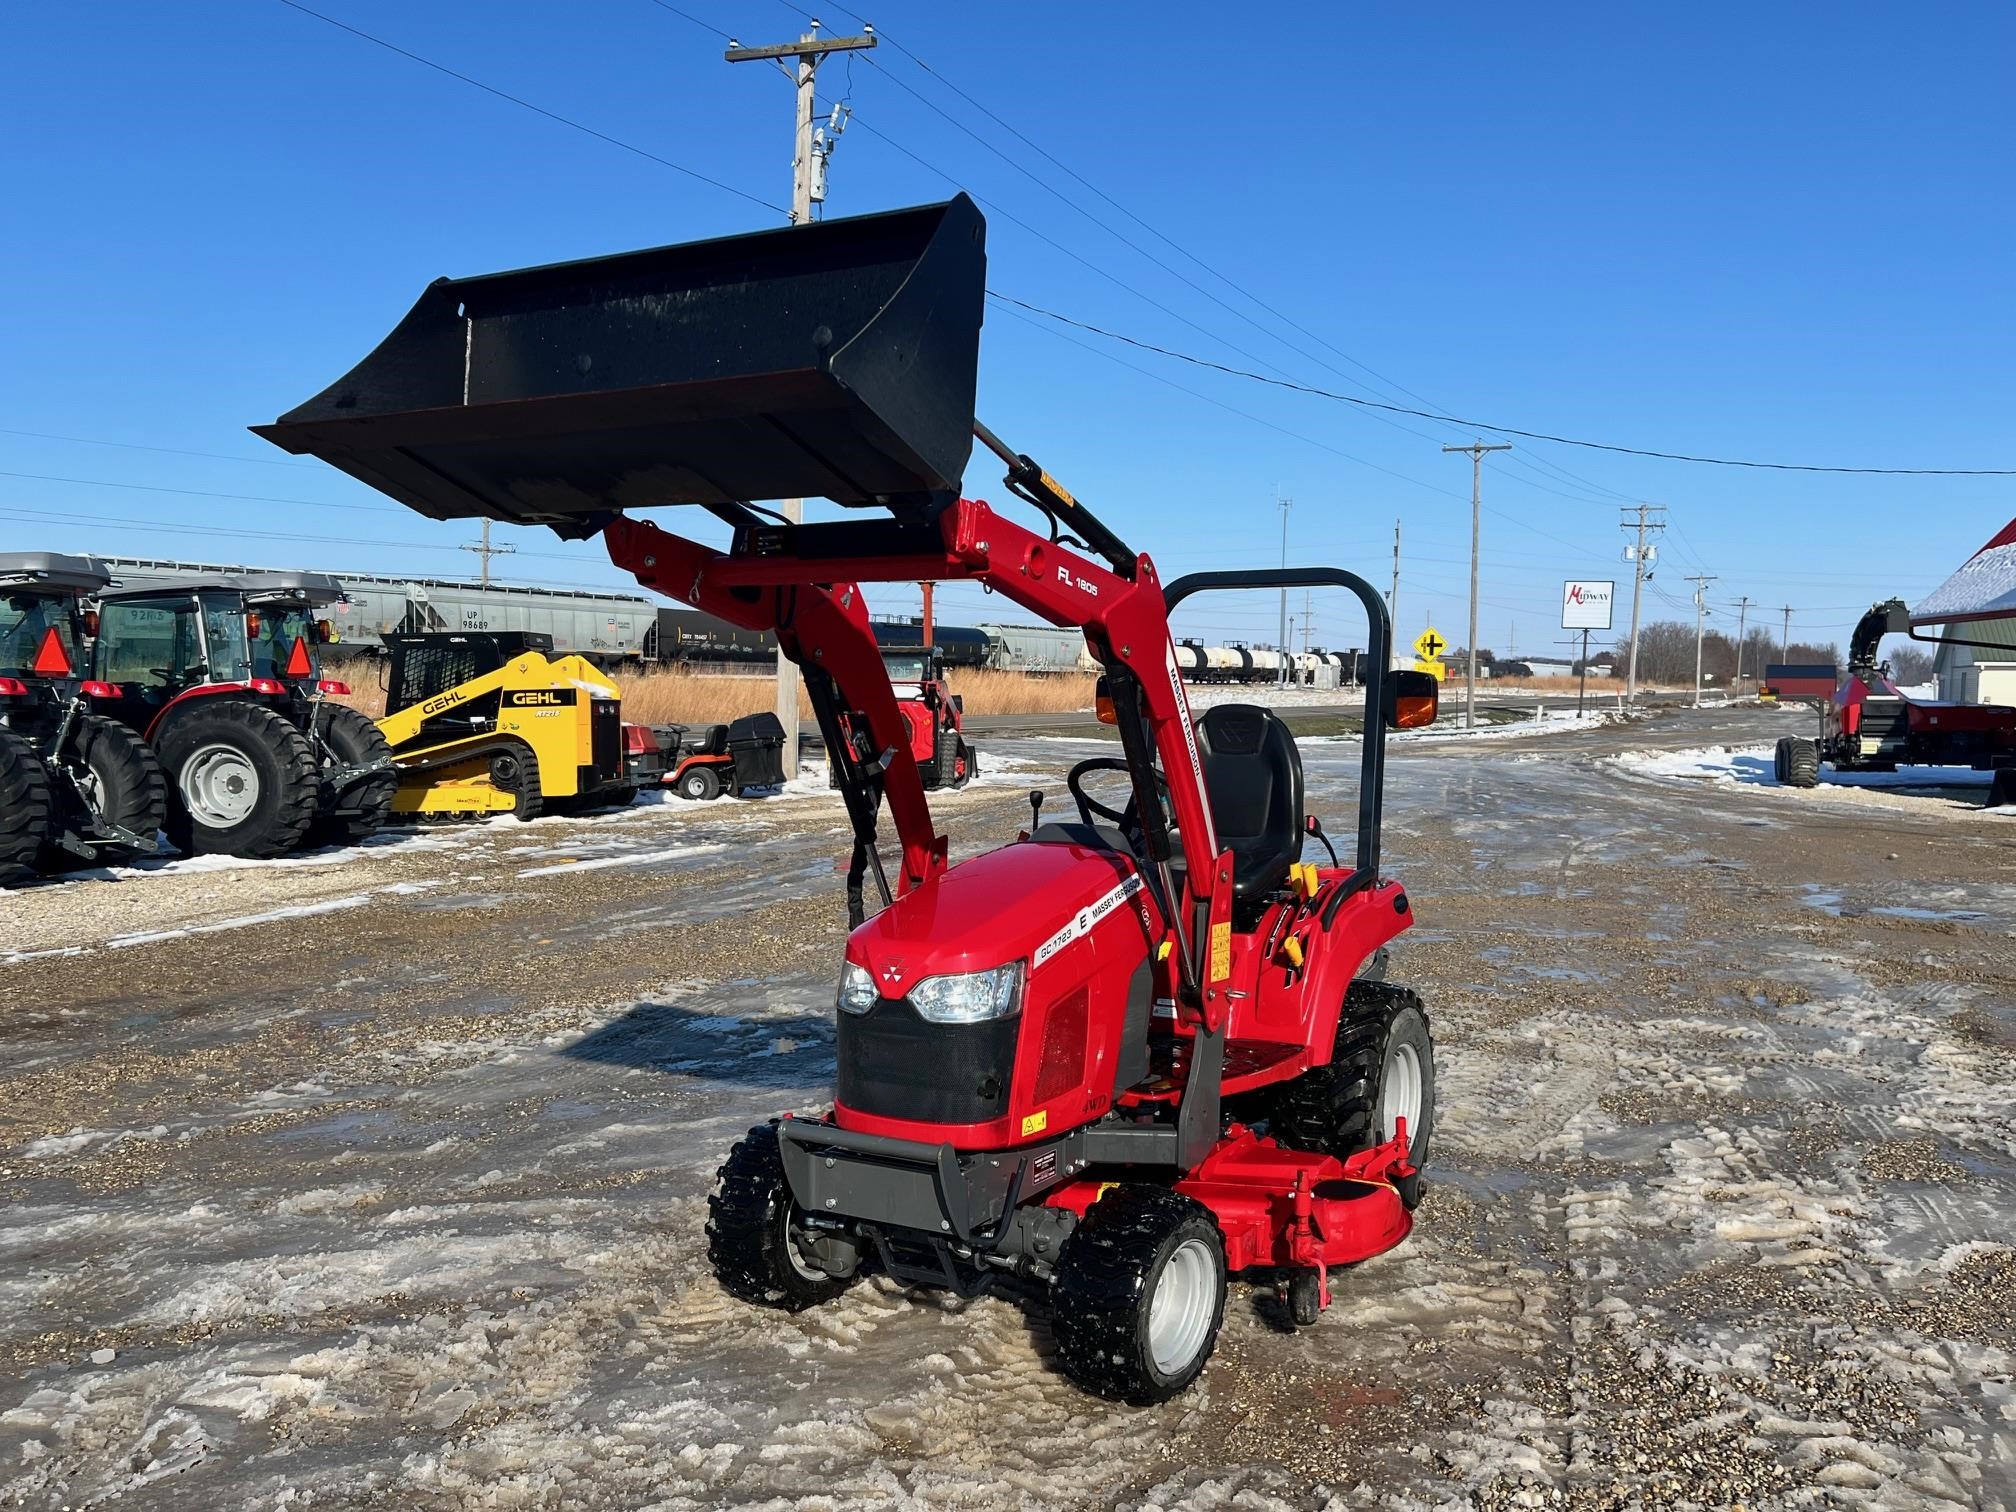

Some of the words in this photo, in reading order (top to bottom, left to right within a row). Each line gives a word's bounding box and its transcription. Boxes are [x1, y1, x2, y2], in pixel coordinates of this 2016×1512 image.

[1058, 566, 1073, 587] FL
[1076, 577, 1098, 597] 1805
[1566, 584, 1609, 605] MIDWAY
[462, 621, 488, 630] 98689
[467, 611, 478, 619] UP
[422, 691, 467, 715] GEHL
[512, 692, 562, 705] GEHL
[1170, 668, 1186, 714] MASSEY
[1183, 717, 1200, 776] FERGUSON
[1040, 944, 1052, 959] GC
[1052, 928, 1072, 949] 1723
[1080, 913, 1087, 930] E
[1092, 896, 1114, 920] MASSEY
[1114, 877, 1141, 902] FERGUSON
